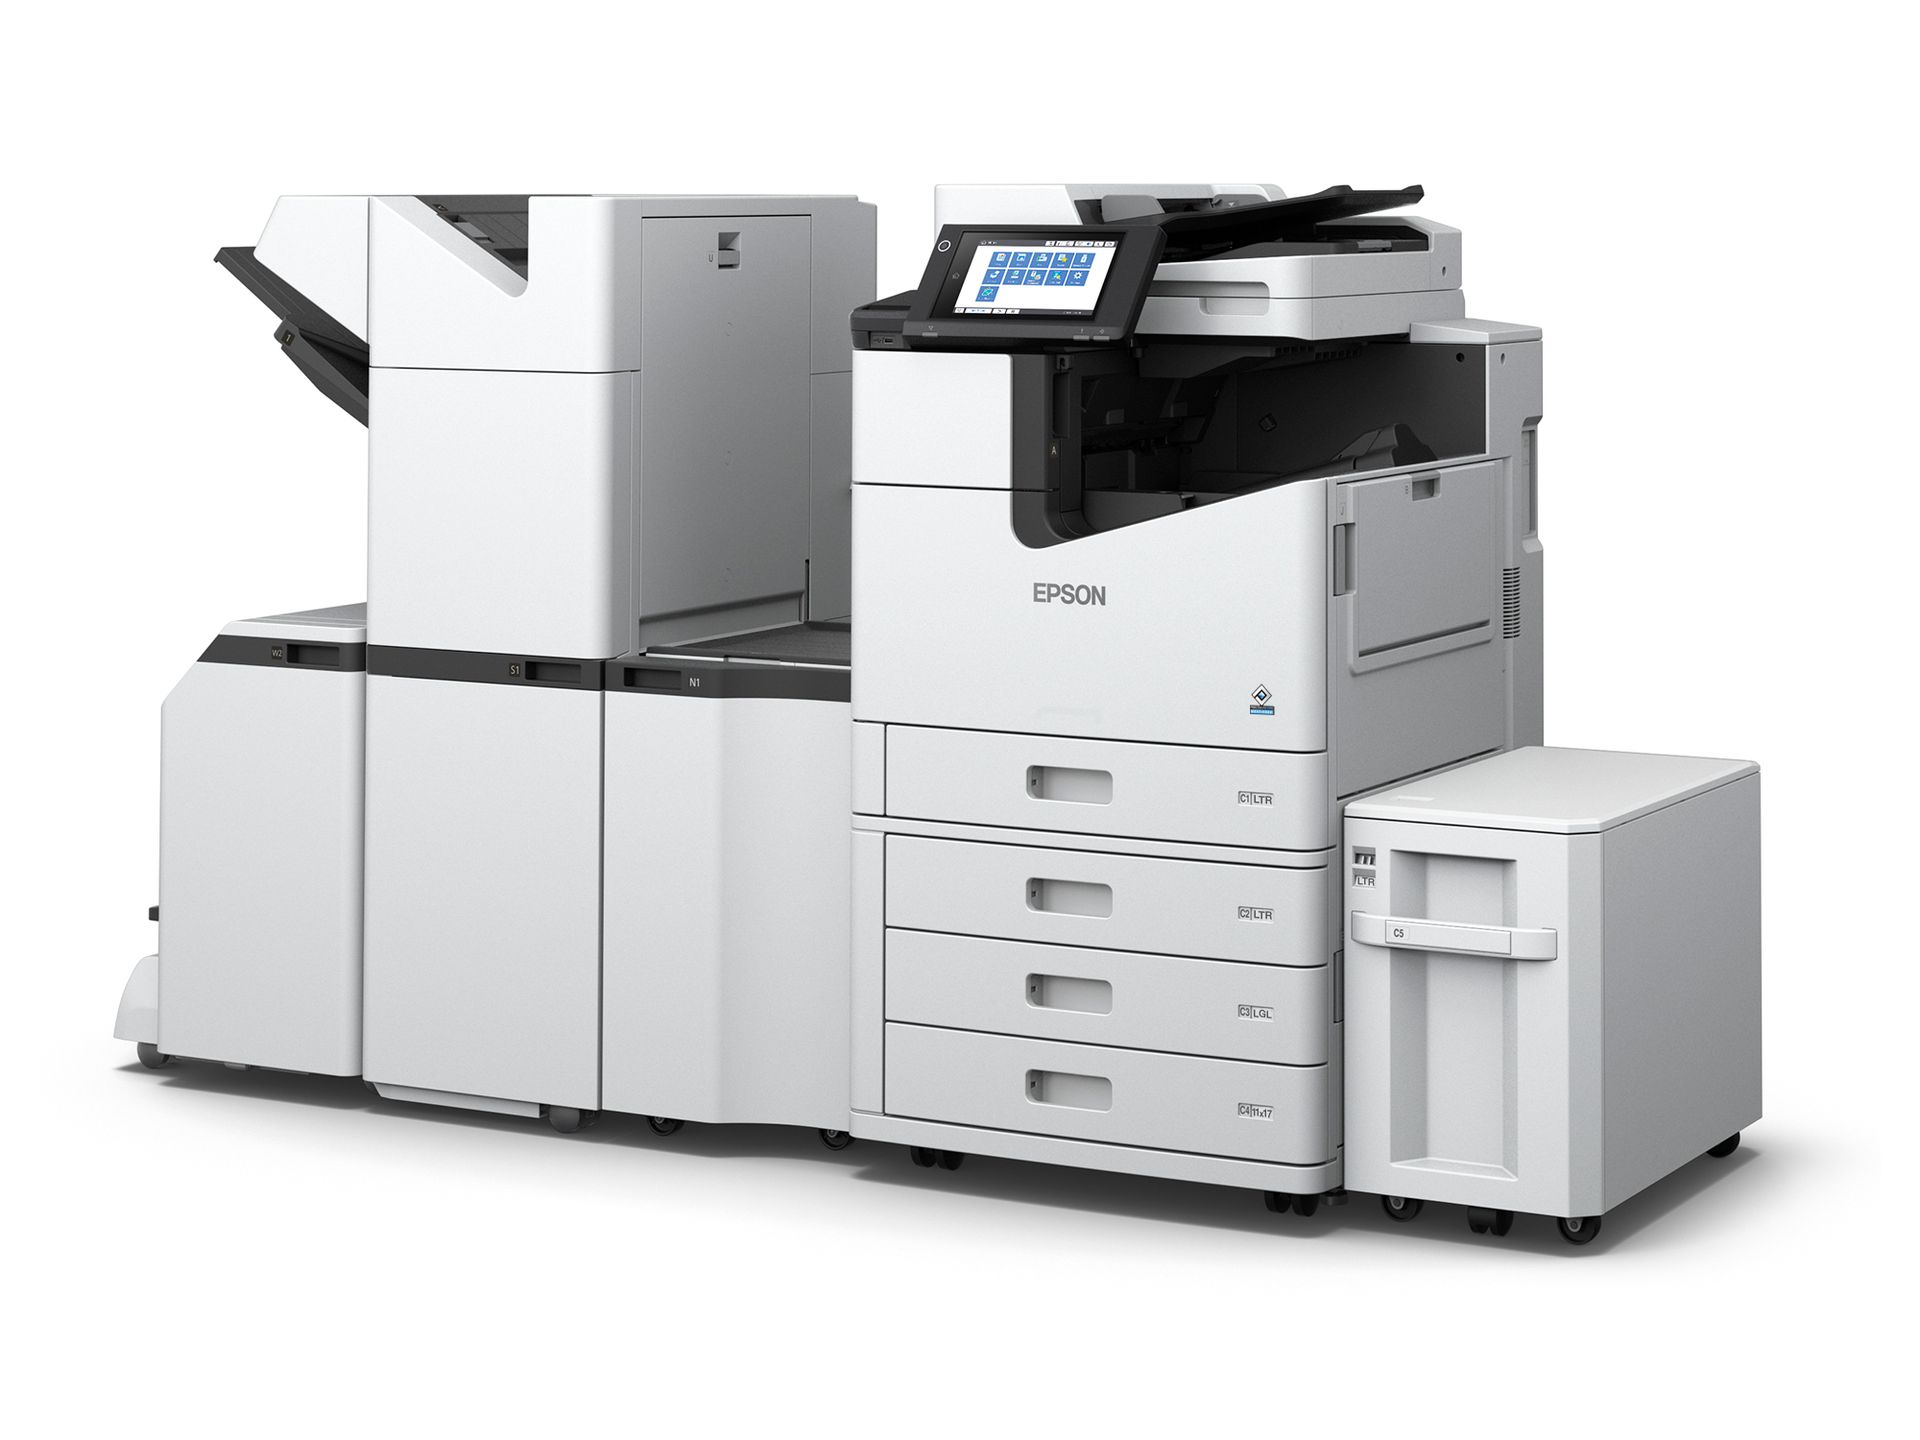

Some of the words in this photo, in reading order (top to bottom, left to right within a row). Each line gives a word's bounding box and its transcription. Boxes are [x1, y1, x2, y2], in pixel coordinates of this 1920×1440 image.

[1051, 445, 1057, 455] A
[1033, 582, 1106, 606] EPSON
[271, 648, 284, 657] W2
[510, 664, 520, 675] S1
[689, 677, 701, 688] N1
[1240, 793, 1250, 803] C1
[1253, 794, 1273, 805] LTR
[1357, 876, 1375, 887] LTR
[1240, 908, 1250, 919] C2
[1253, 909, 1273, 921] LTR
[1393, 928, 1404, 938] C5
[1240, 1007, 1250, 1017] C3
[1253, 1009, 1273, 1019] LGL
[1240, 1105, 1250, 1115] C4
[1251, 1107, 1273, 1119] 11x17
